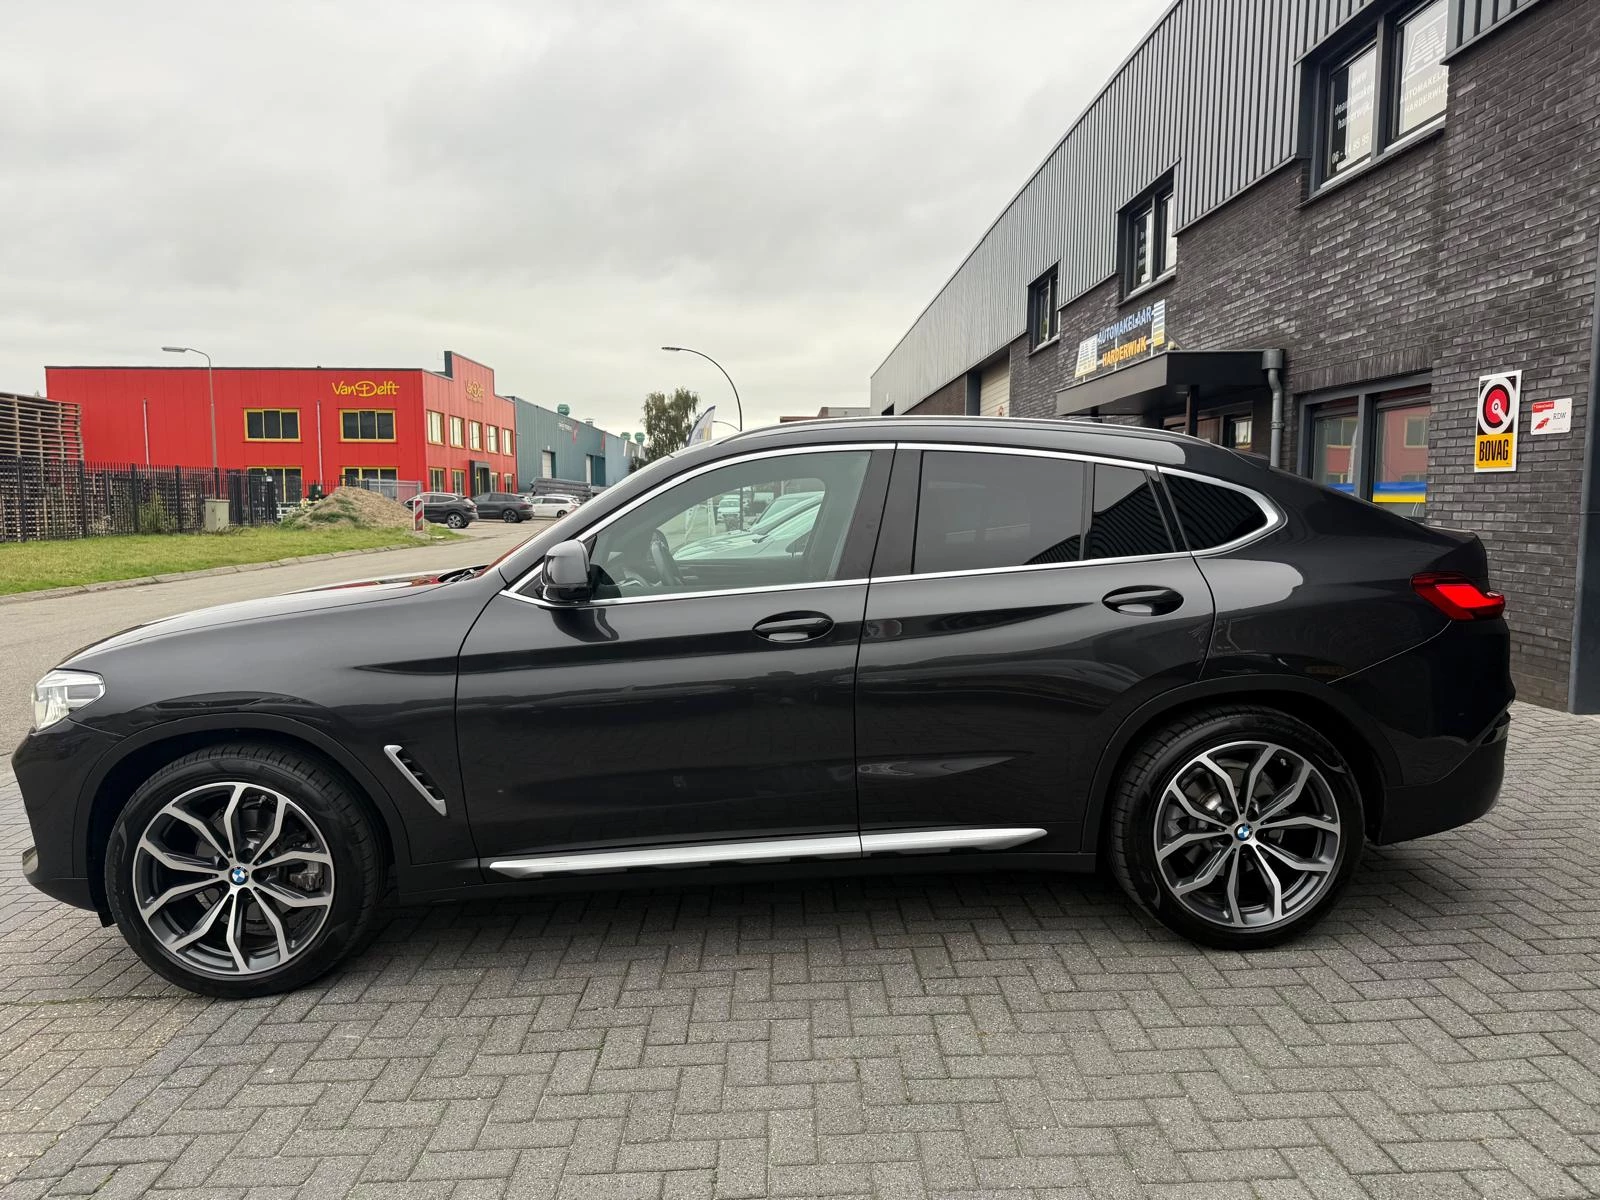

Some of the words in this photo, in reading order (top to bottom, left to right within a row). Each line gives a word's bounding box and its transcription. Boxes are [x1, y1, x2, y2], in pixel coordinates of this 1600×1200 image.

[1098, 306, 1152, 345] AUTOMAKELAAR
[1102, 335, 1146, 367] HARDERWIJK
[1479, 439, 1509, 462] BOVAG
